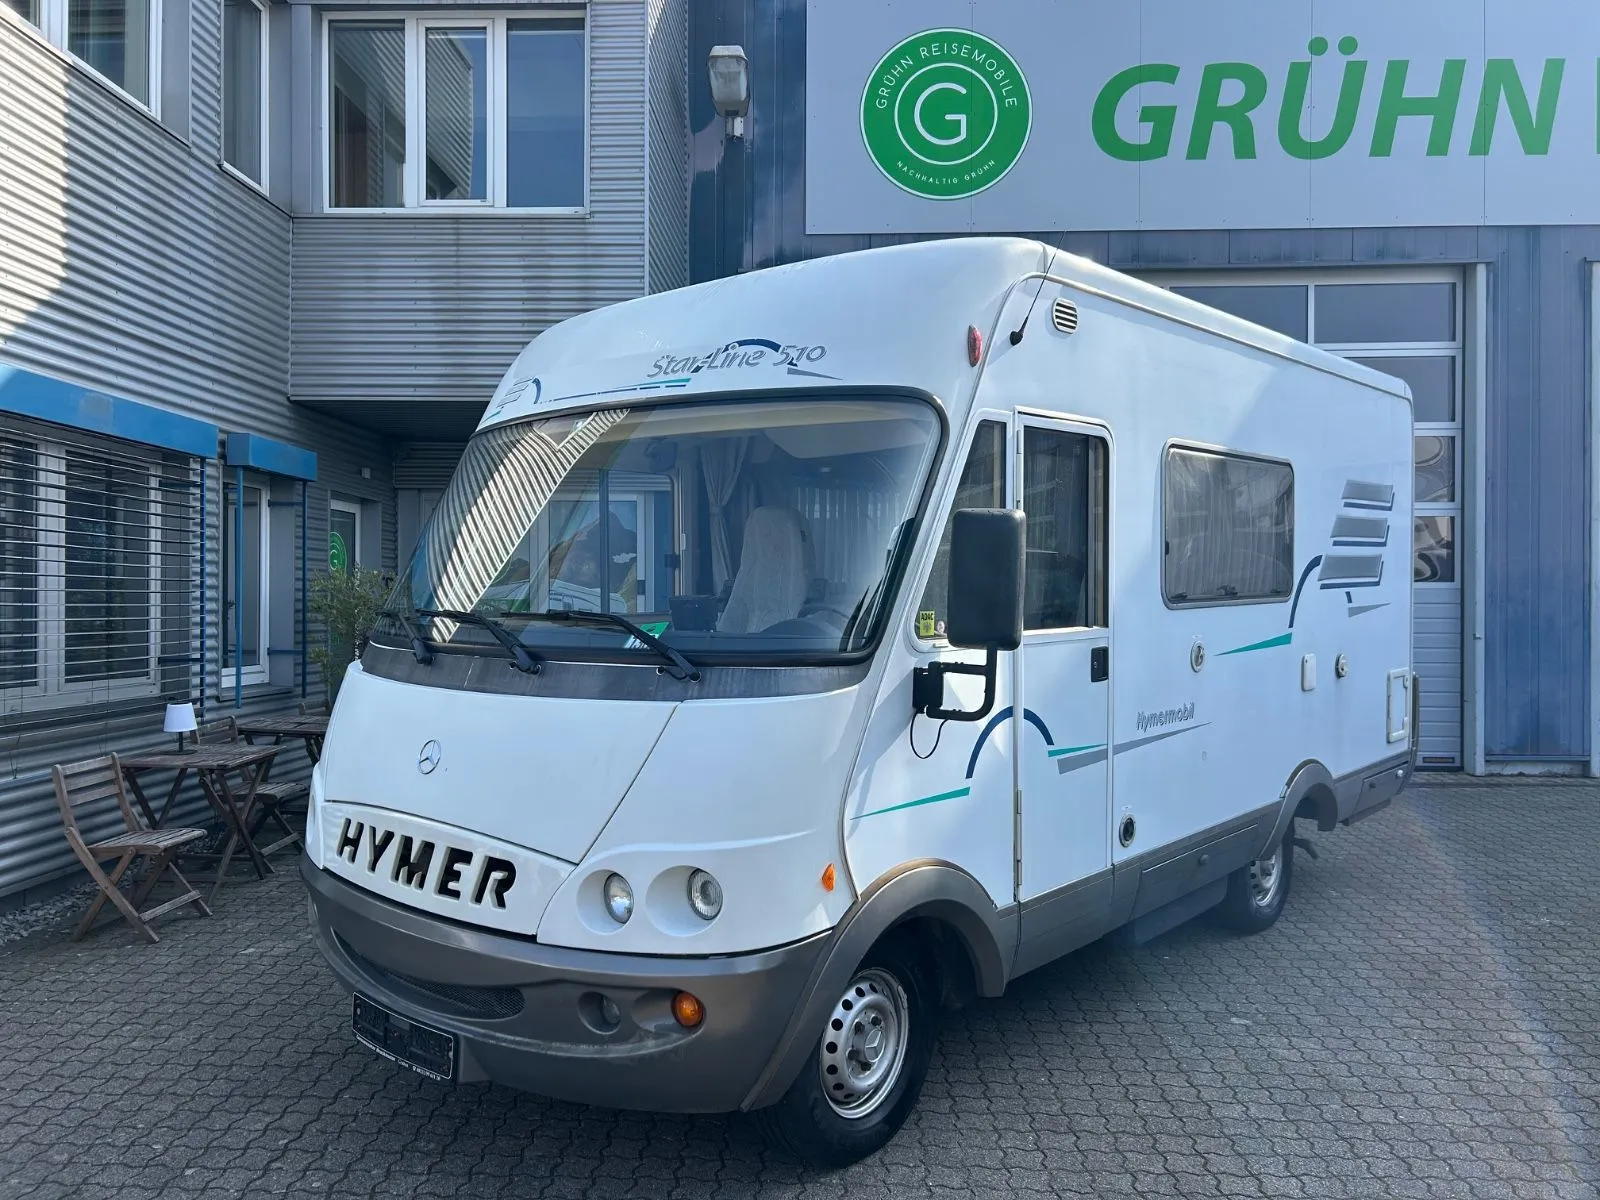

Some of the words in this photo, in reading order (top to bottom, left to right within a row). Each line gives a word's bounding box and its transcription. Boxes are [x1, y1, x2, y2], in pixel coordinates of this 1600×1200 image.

[876, 55, 914, 109] GRÜHN
[919, 42, 1018, 107] REISEMOBILE
[1091, 35, 1566, 162] GRÜHN
[914, 82, 967, 146] G
[896, 160, 959, 184] NACHHALTIG
[964, 159, 996, 181] GRÜHN
[772, 345, 828, 367] 510
[1136, 701, 1195, 733] Hymermobil
[336, 817, 517, 911] HYMER
